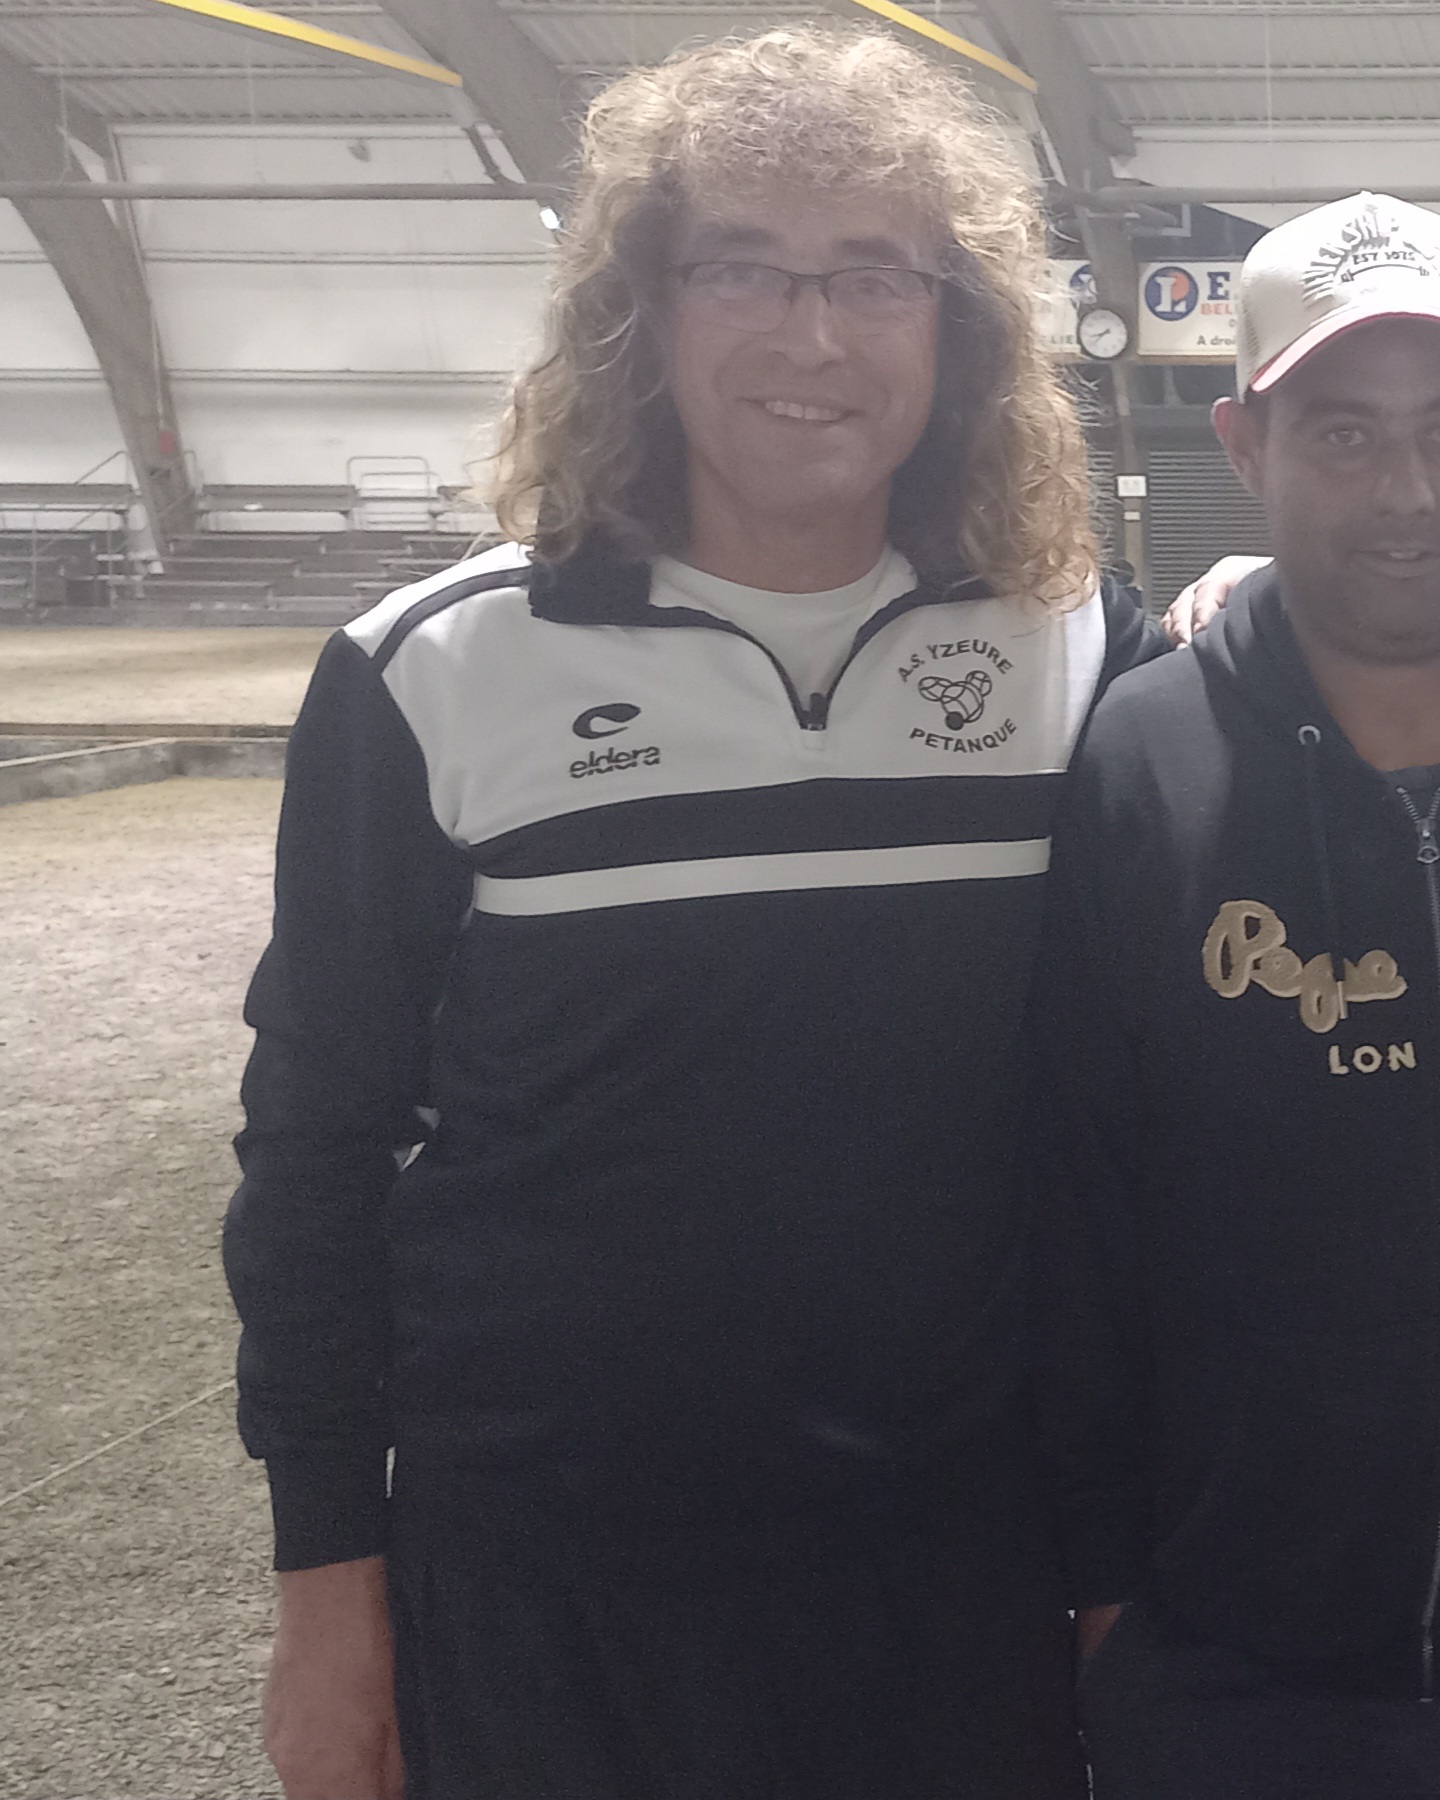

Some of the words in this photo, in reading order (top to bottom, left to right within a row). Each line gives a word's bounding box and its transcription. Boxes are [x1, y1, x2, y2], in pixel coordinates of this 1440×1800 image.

[926, 639, 1014, 675] YZEURE
[909, 717, 1017, 753] PETANQUE
[569, 746, 661, 779] eldera
[1202, 900, 1408, 1033] Pepe
